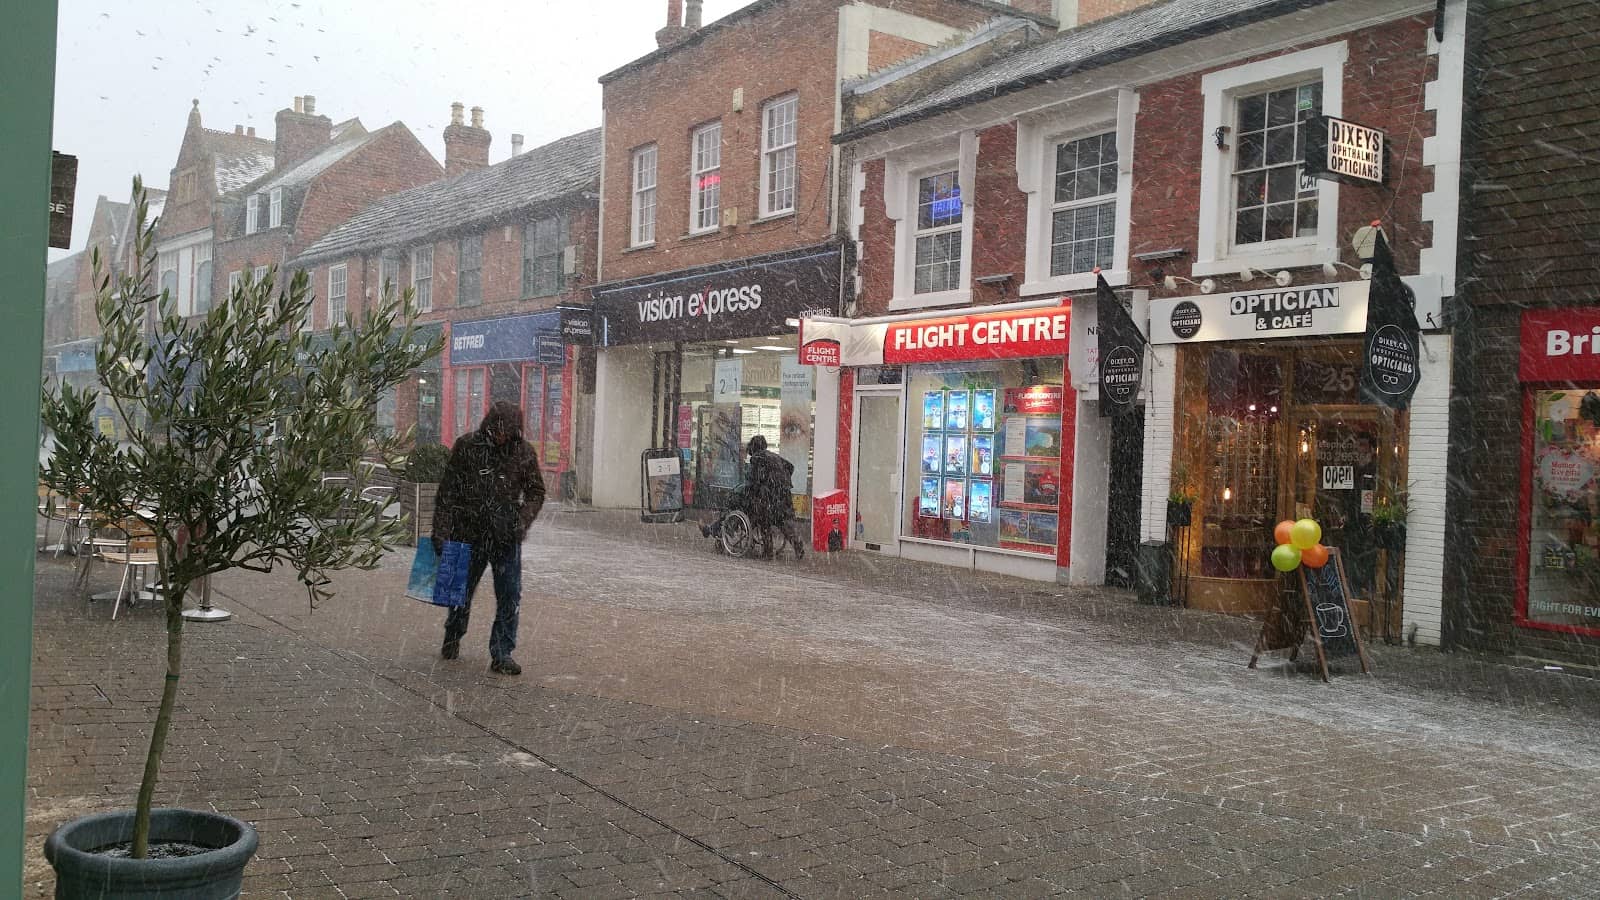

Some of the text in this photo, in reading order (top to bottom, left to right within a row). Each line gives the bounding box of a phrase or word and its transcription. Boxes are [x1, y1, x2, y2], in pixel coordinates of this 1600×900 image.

[1331, 121, 1380, 152] DIXEYS
[1332, 143, 1379, 164] OPHTHALMIC
[1331, 155, 1379, 179] OPTICIANS
[638, 281, 762, 322] vision express
[1231, 288, 1339, 315] OPTICIAN
[568, 319, 589, 327] vision
[1172, 318, 1201, 327] OPTICIANS
[1256, 312, 1312, 330] & CAFÉ
[453, 334, 485, 350] BETFRED
[894, 314, 1067, 350] FLIGHT CENTRE
[1546, 326, 1600, 356] Bri
[806, 354, 838, 363] CENTRE
[807, 346, 837, 355] FLIGHT
[1371, 354, 1413, 374] OPTICIANS
[1321, 367, 1355, 392] 25
[1325, 465, 1352, 489] open
[1531, 600, 1561, 612] FIGHT
[1562, 604, 1582, 615] FOR
